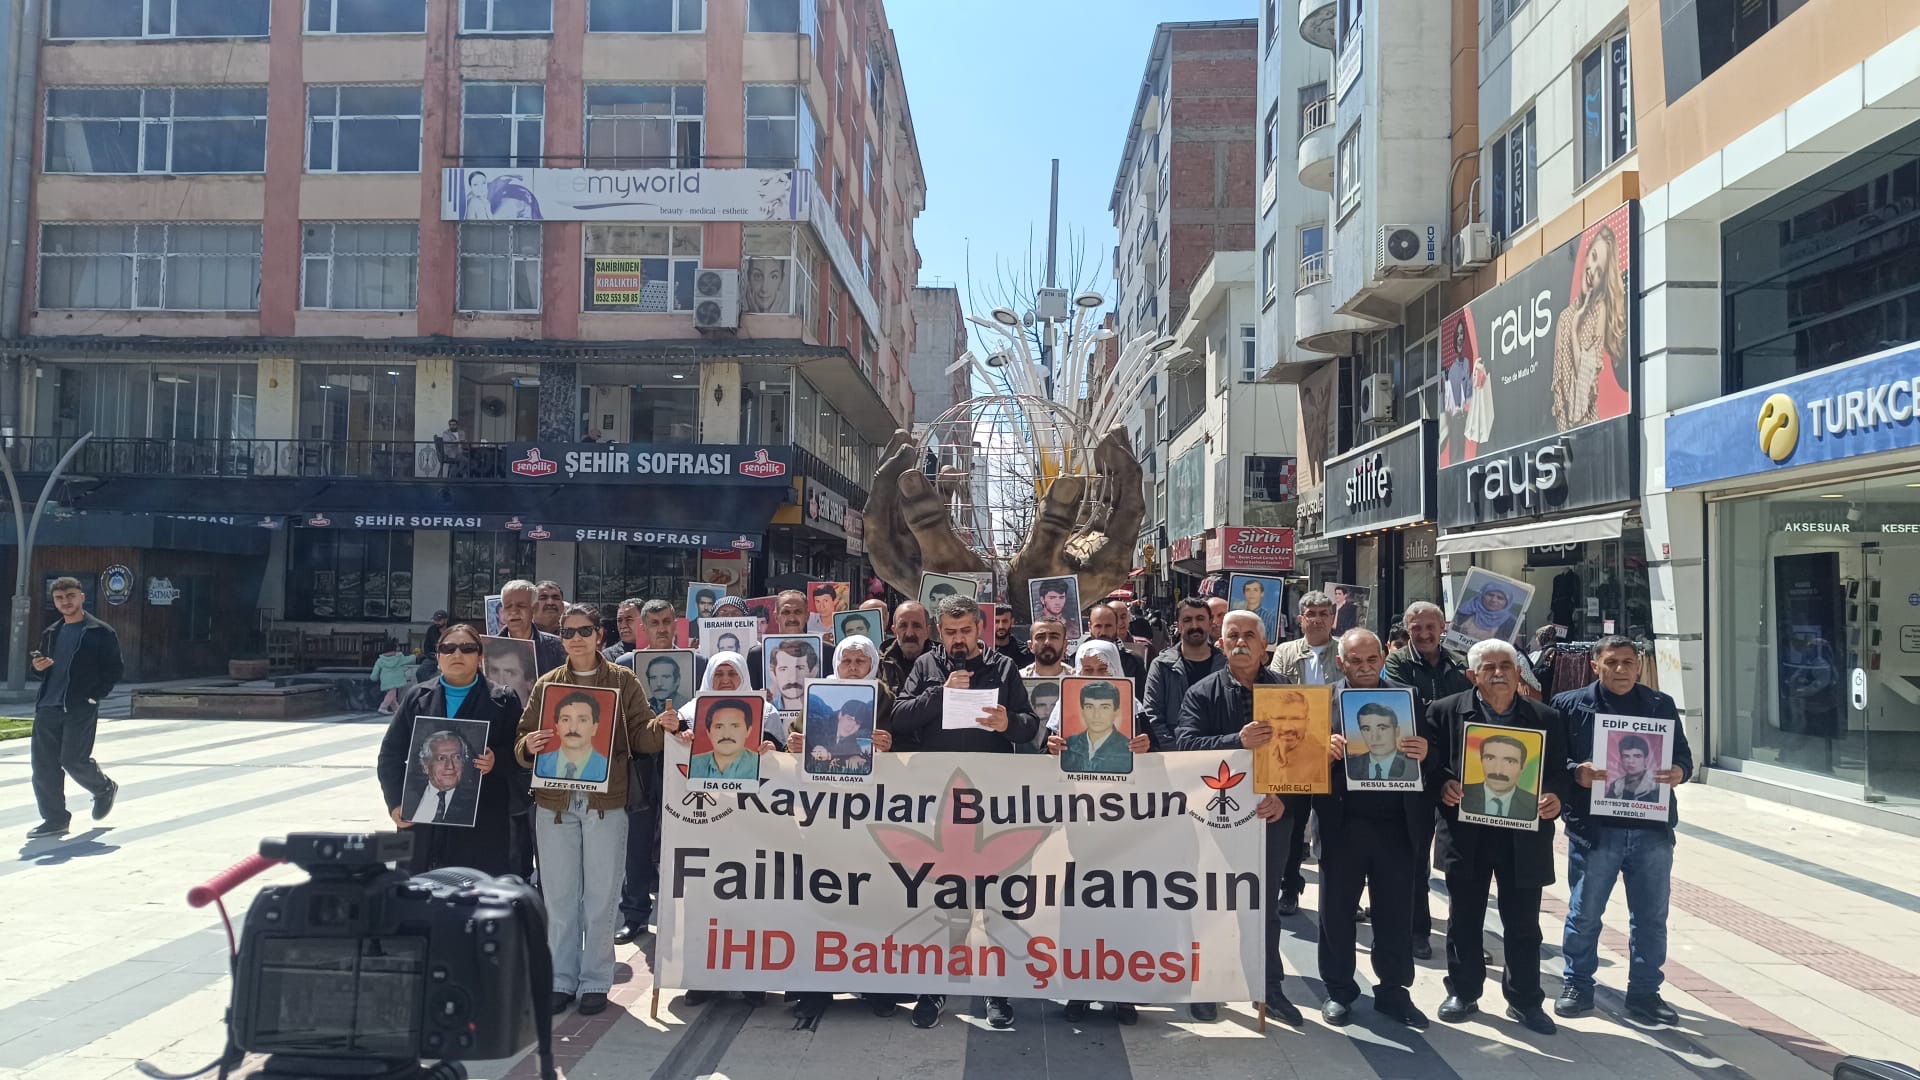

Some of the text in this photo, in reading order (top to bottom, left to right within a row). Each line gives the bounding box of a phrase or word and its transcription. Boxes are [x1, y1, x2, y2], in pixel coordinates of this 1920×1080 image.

[659, 206, 749, 216] beauty medical esthetic
[1427, 226, 1435, 261] BEKO
[596, 260, 640, 272] SAHİBİNDEN
[596, 293, 610, 303] 0532
[611, 293, 622, 303] 553
[1490, 289, 1553, 361] rays
[565, 446, 731, 478] ŞEHİR SOFRASI
[1345, 453, 1389, 506] stilife
[354, 514, 482, 528] ŞEHİR SOFRASI
[1785, 523, 1851, 533] AKSESUAR
[575, 528, 708, 545] ŞEHİR SOFRASI
[1238, 530, 1281, 545] Şirin
[1229, 544, 1290, 554] Collection
[704, 619, 755, 629] İBRAHİM ÇELİK
[1602, 719, 1667, 733] EDİP ÇELİK
[703, 780, 743, 790] İSA GÖK
[838, 774, 864, 783] AĞAYA
[1268, 783, 1312, 792] TAHİR ELÇİ
[737, 776, 1188, 829] Kayıplar Bulunsun
[682, 816, 709, 825] HAKLARI
[1206, 821, 1232, 829] HAKLARI
[673, 847, 1261, 921] Failler Yargılansın
[706, 917, 1201, 990] İHD Batman Şubesi
